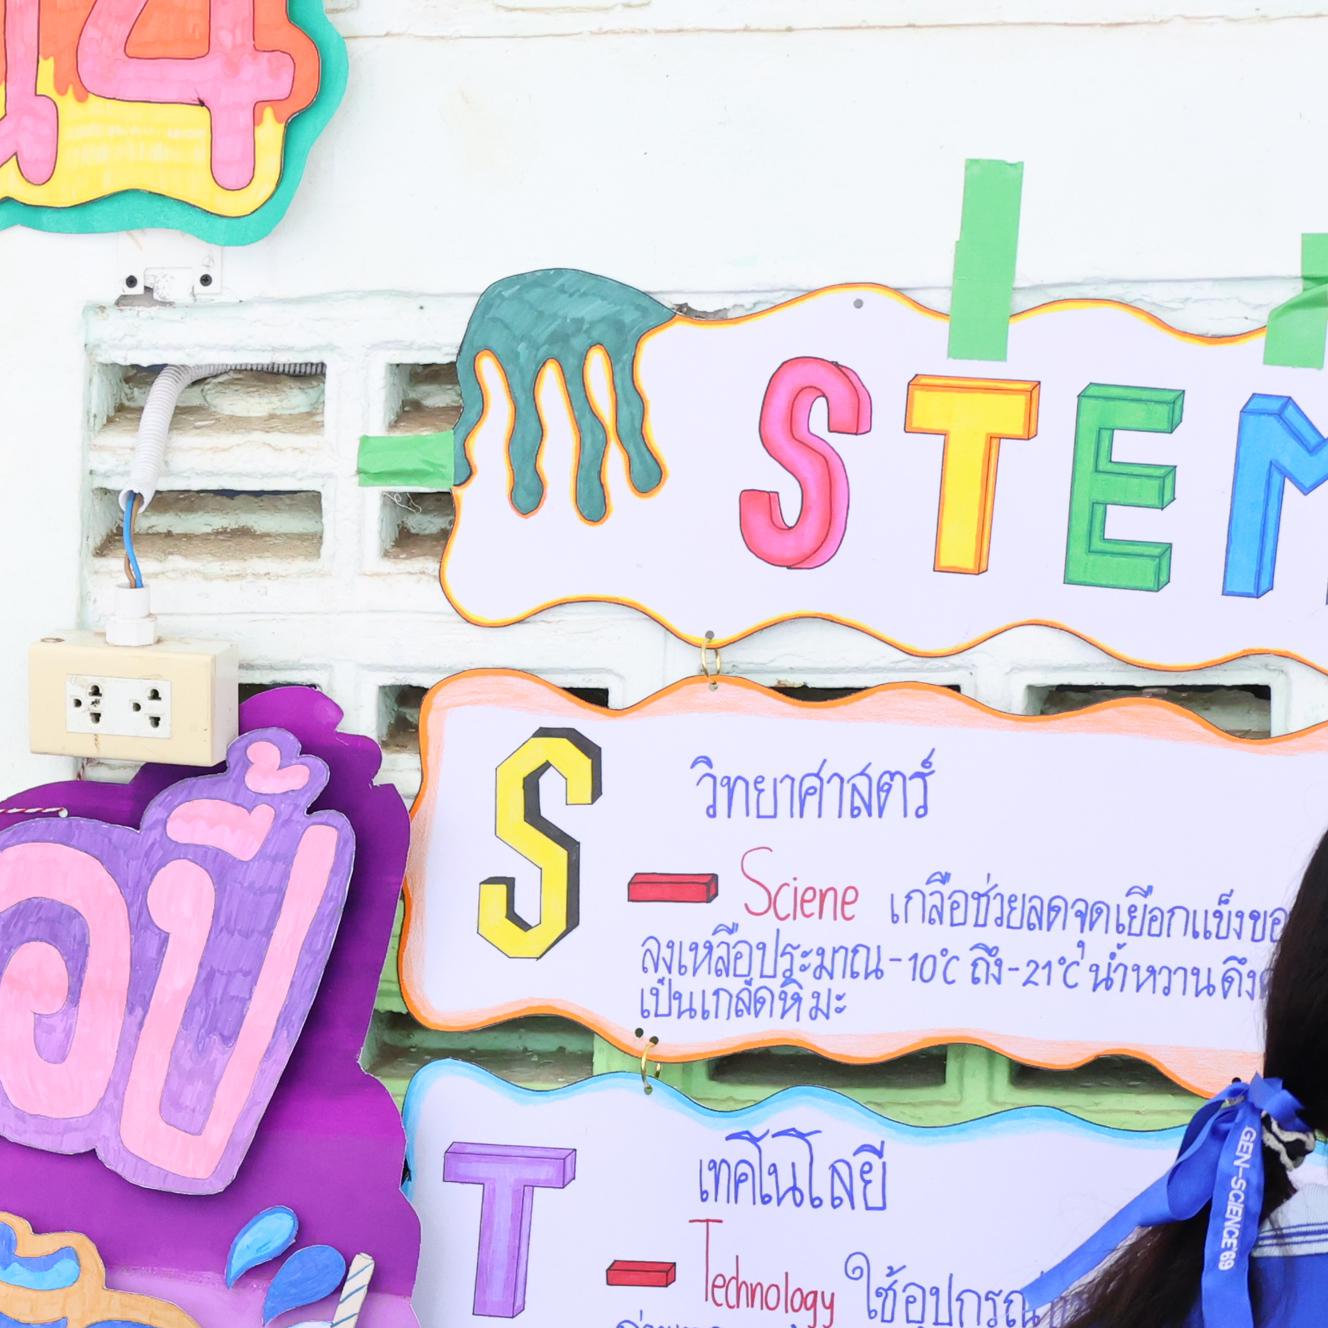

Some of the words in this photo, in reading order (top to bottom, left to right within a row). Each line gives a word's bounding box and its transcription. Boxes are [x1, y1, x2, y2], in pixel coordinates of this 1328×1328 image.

[740, 355, 1328, 605] STEM
[689, 747, 936, 819] วิทยาศาสตร์
[477, 727, 603, 960] S
[740, 846, 859, 921] Sciene
[640, 922, 884, 980] ลงเหลือประมาณ
[698, 1127, 887, 1212] เทคโนโลยี
[443, 1141, 577, 1319] T
